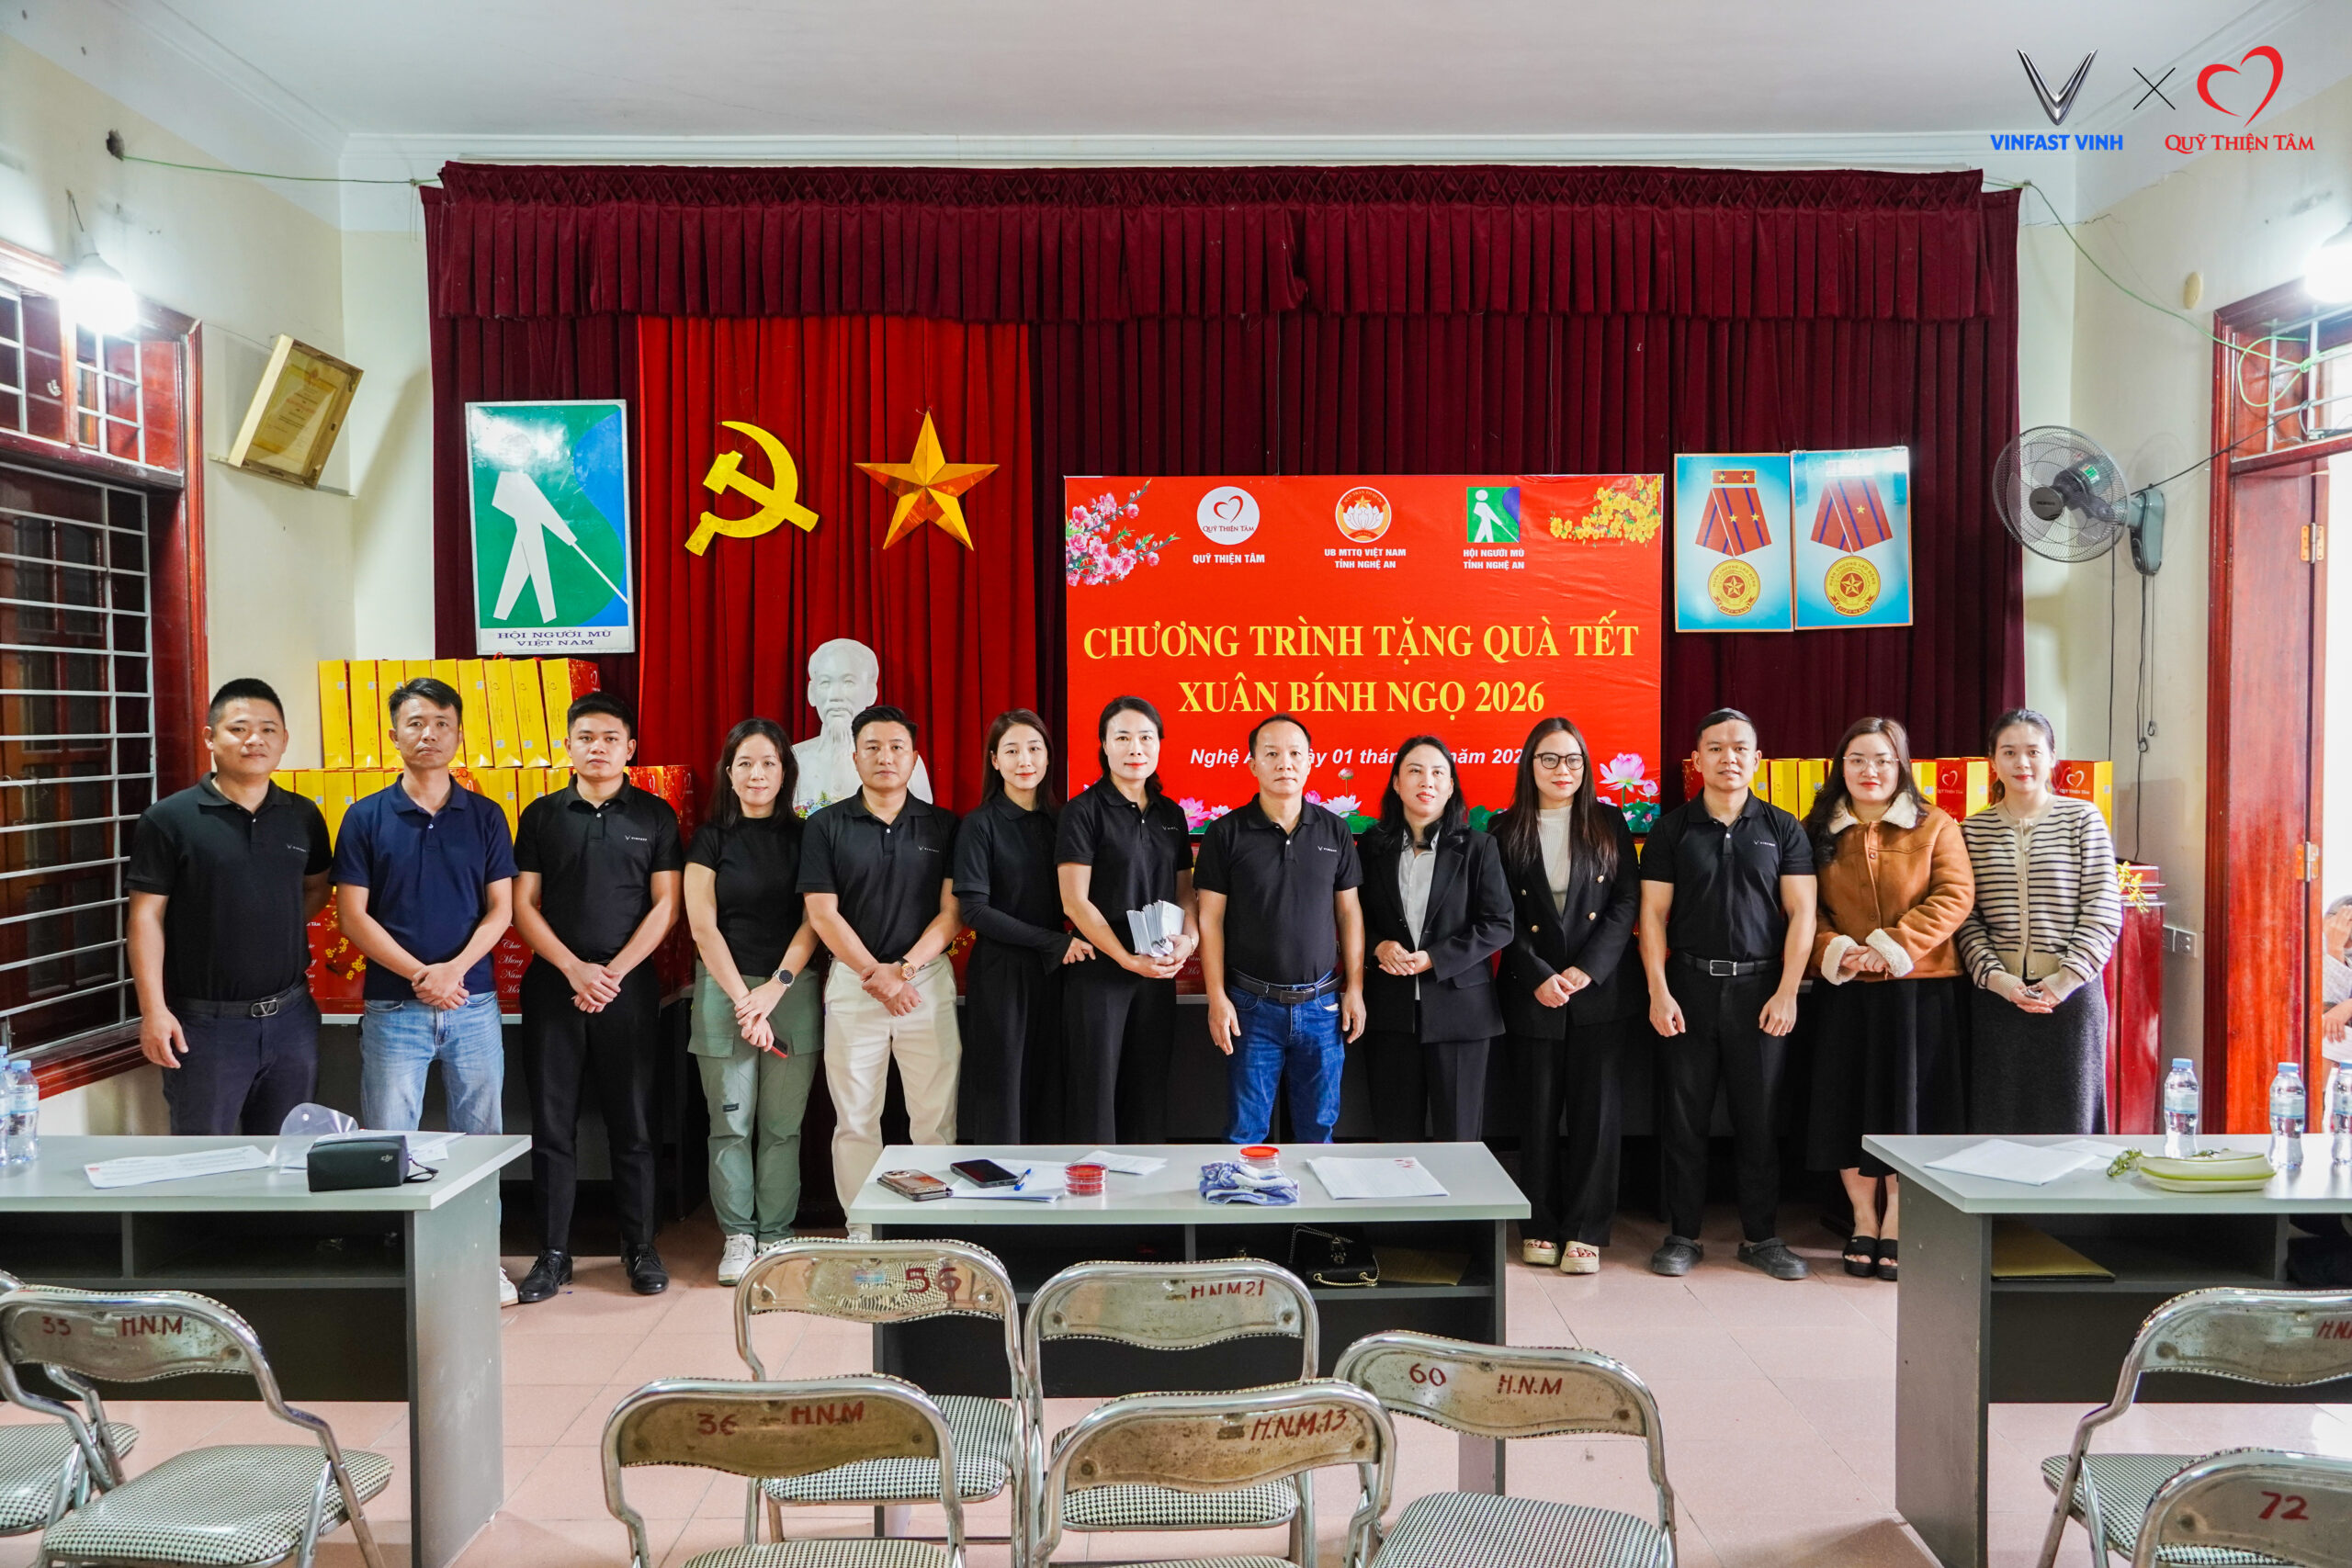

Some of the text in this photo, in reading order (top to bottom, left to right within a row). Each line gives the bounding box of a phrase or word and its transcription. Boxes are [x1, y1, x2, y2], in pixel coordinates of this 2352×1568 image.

[1193, 552, 1265, 565] QUỸ THIỆN TÂM
[1324, 547, 1406, 558] UB MTTQ VIỆT NAM
[1463, 547, 1524, 558] HỘI NGƯỜI MÙ
[1335, 558, 1396, 570] TỈNH NGHỆ AN
[1463, 558, 1525, 570] TỈNH NGHỆ AN
[498, 629, 612, 640] HỘI NGƯỜI MÙ
[1084, 610, 1639, 665] CHƯƠNG TRÌNH TẶNG QUÀ TẾT
[517, 639, 553, 648] VIỆT
[1178, 671, 1544, 720] XUÂN BÍNH NGỌ 2026
[1190, 749, 1239, 768] Nghệ
[1332, 749, 1353, 764] 01
[906, 1267, 962, 1298] 56
[1409, 1363, 1563, 1395] 60 H.N.M
[696, 1412, 738, 1436] 36
[2258, 1491, 2309, 1520] 72
